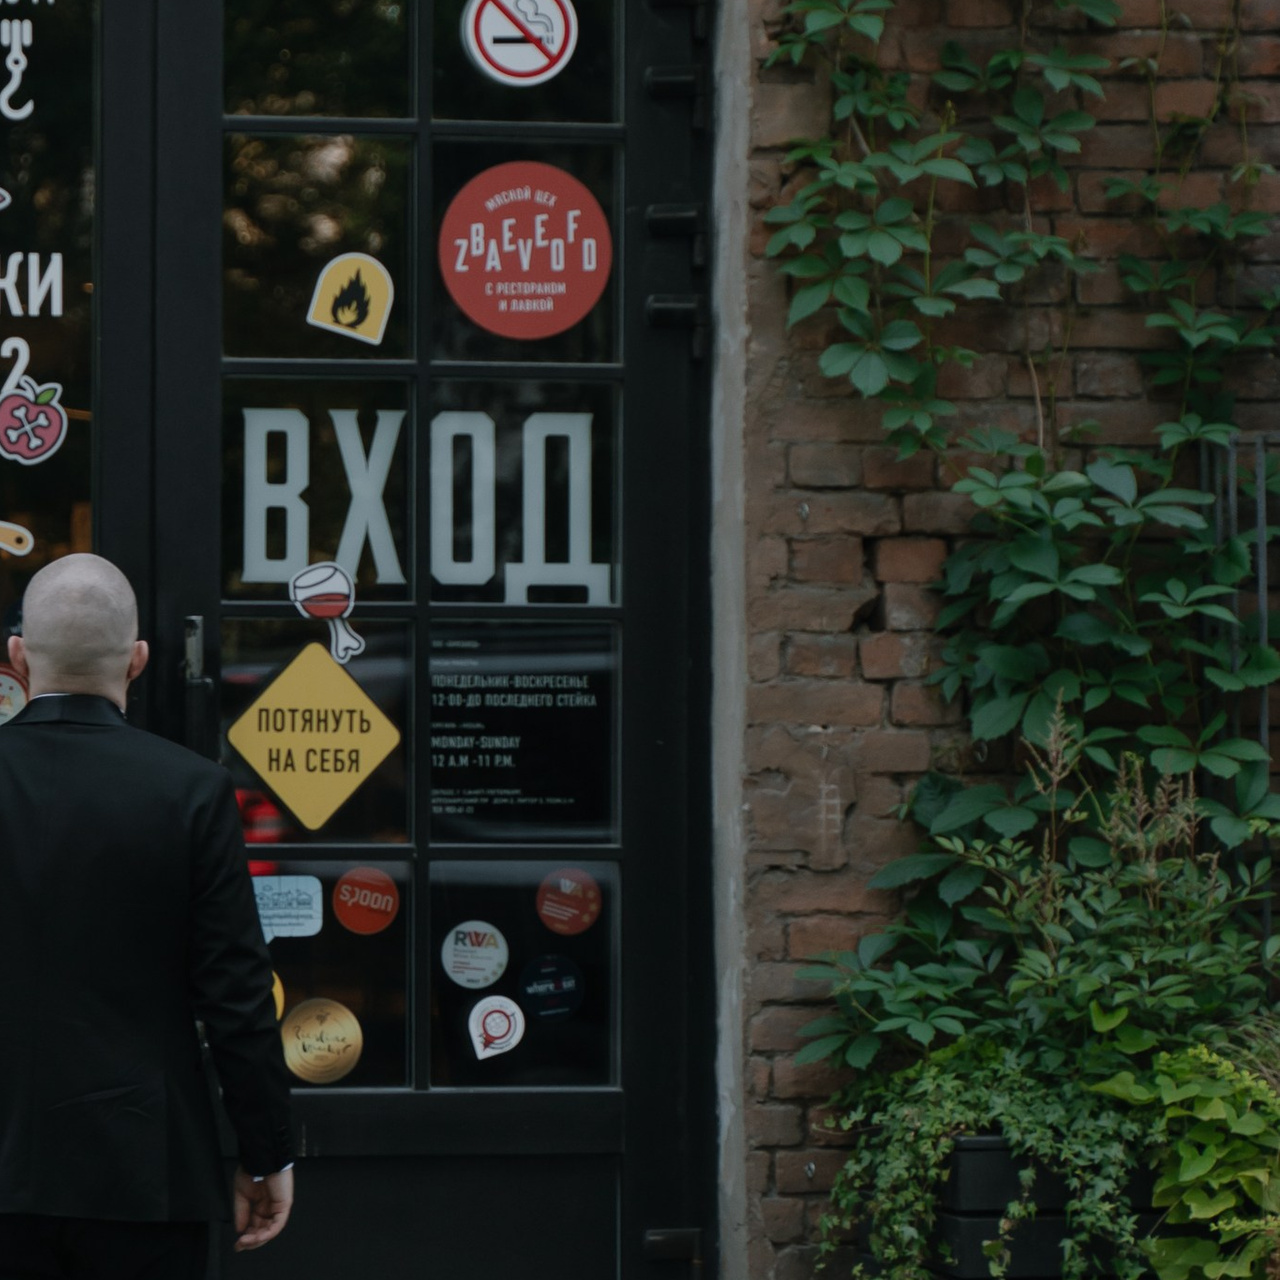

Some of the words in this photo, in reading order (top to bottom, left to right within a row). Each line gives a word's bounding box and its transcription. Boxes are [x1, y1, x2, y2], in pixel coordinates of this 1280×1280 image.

[484, 184, 531, 212] МЯСНОЙ
[534, 189, 558, 208] ЦЕХ
[484, 281, 493, 296] С
[495, 281, 567, 296] РЕСТОРАНОМ
[498, 298, 507, 312] И
[509, 295, 554, 312] ЛАВКОЙ
[241, 408, 610, 605] ВХОД
[484, 692, 553, 707] ПОСЛЕДНЕГО
[557, 691, 597, 707] СТЕЙКА
[257, 707, 371, 734] ПОТЯНУТЬ
[430, 735, 521, 749] MONDAY-SUNDAY
[268, 748, 296, 772] НА
[305, 748, 360, 773] СЕБЯ
[431, 754, 445, 768] 12
